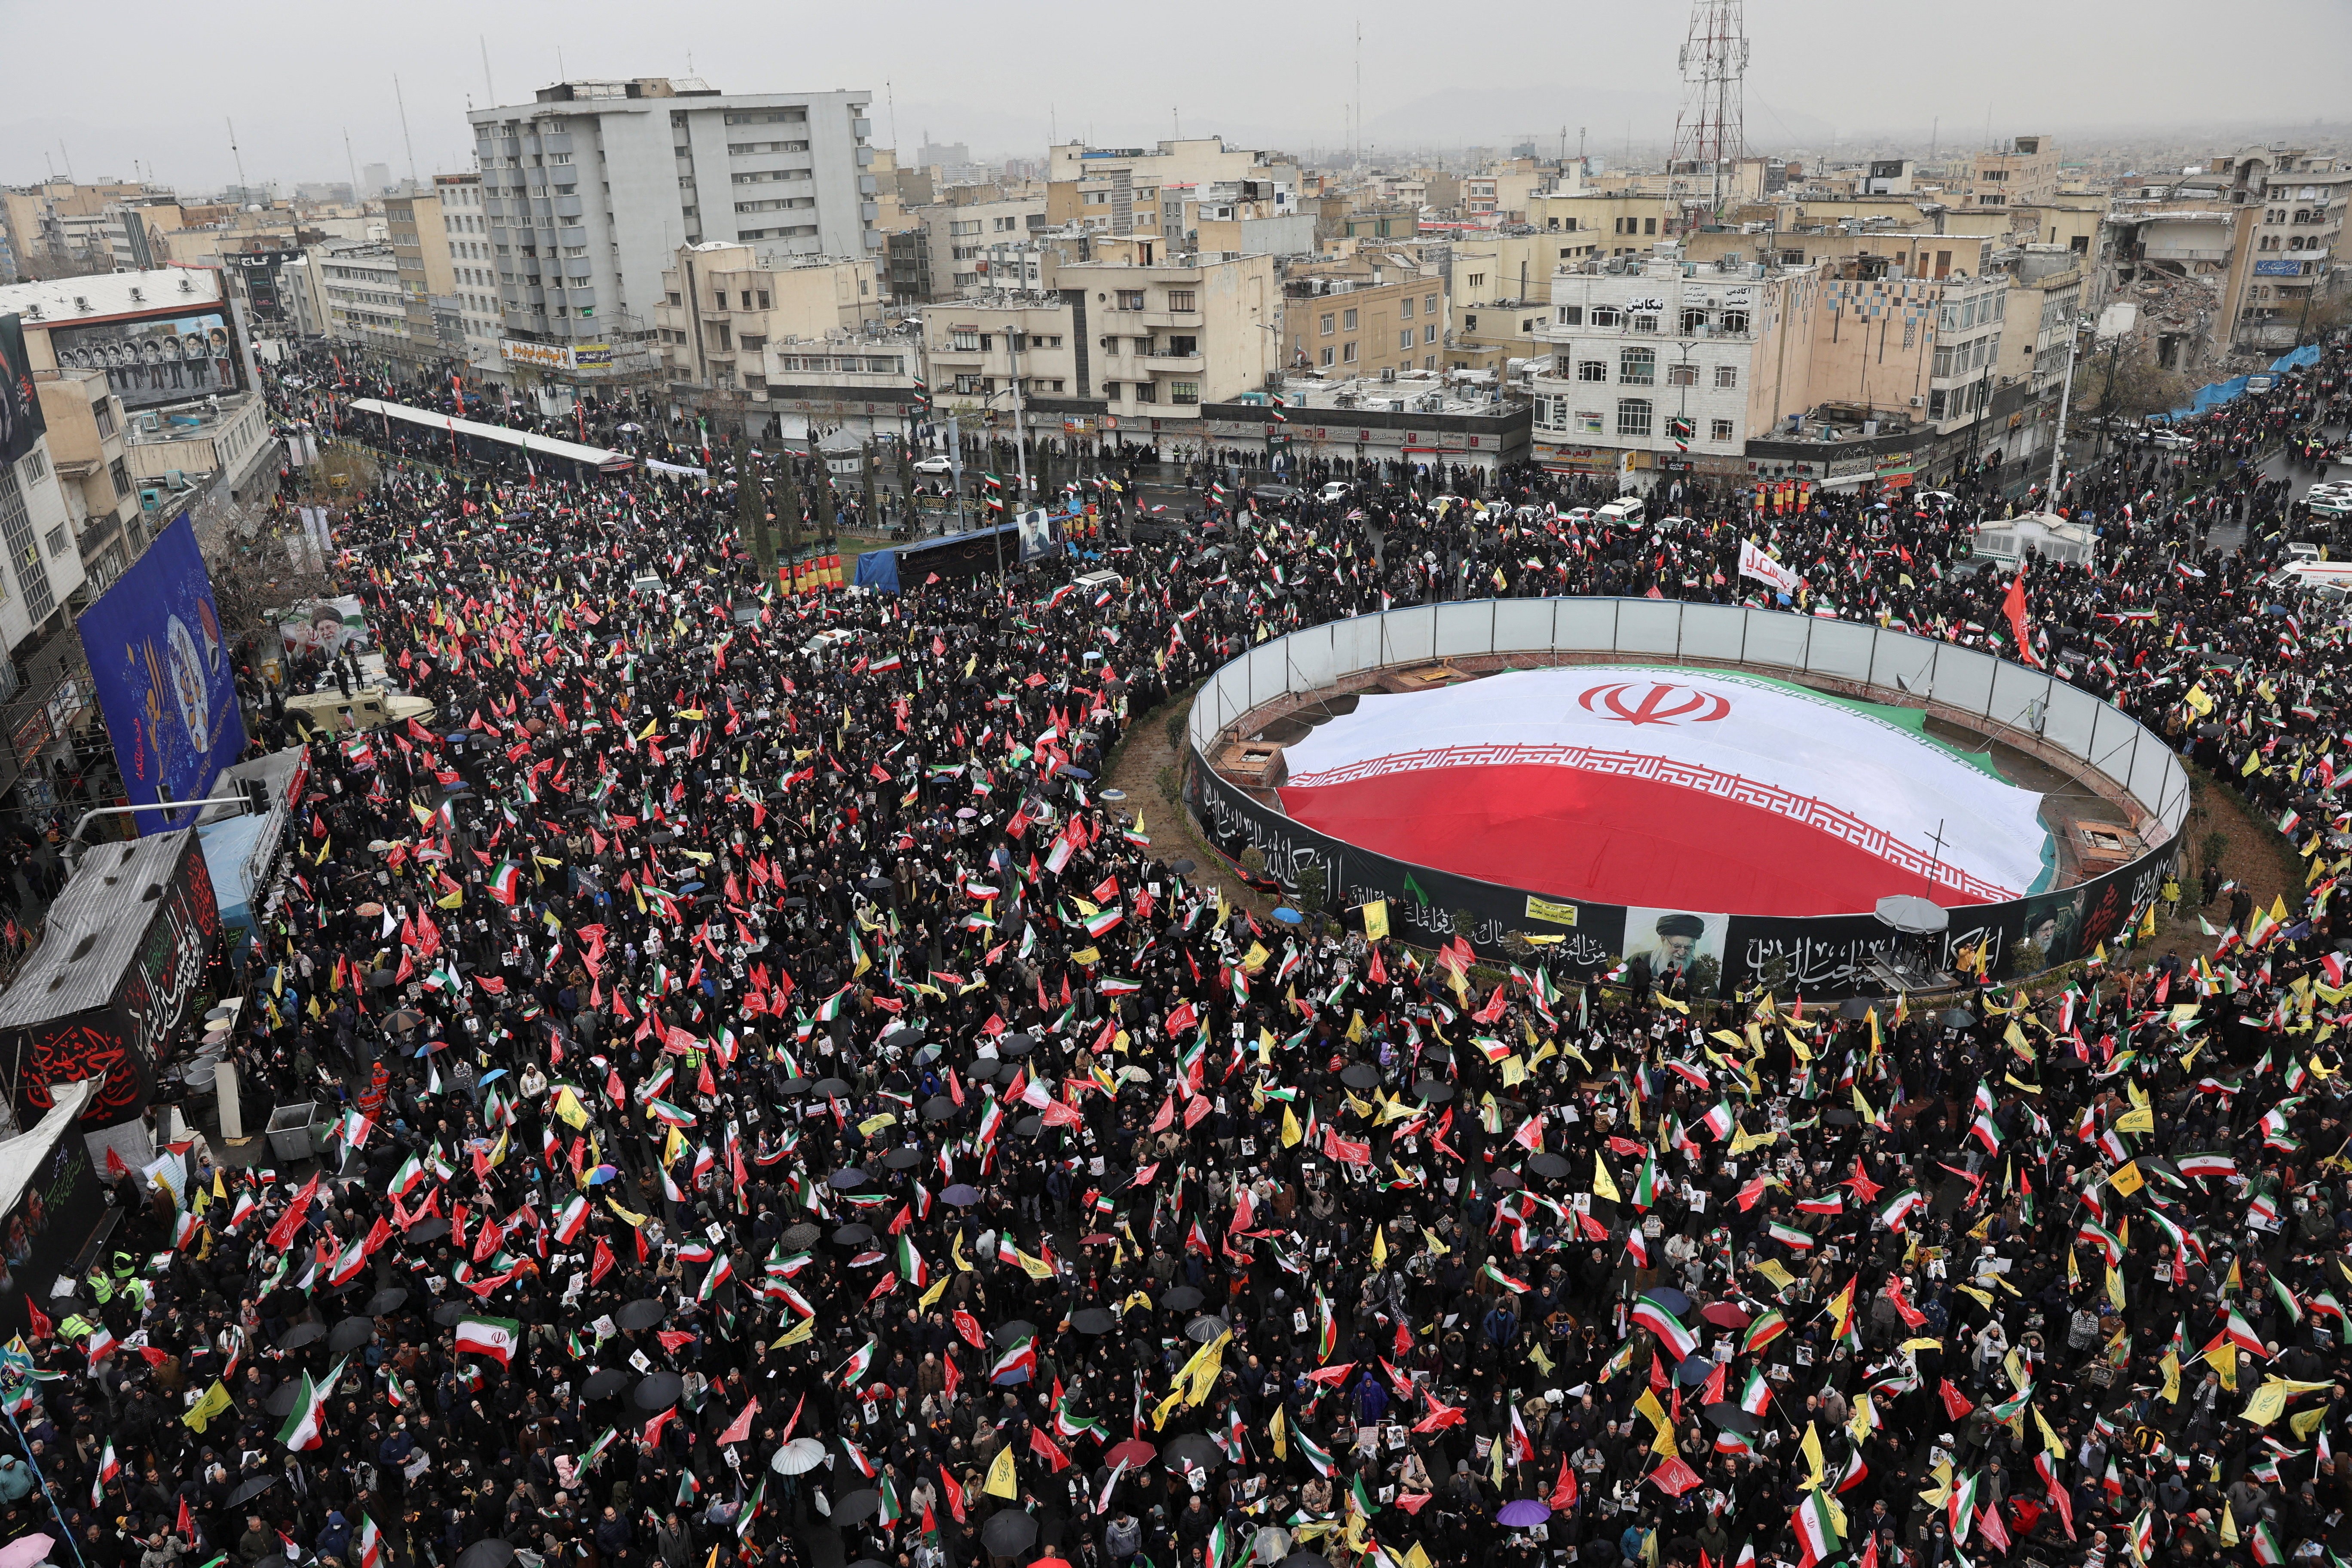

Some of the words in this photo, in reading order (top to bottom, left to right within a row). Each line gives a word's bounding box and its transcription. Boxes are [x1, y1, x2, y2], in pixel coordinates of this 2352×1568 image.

[241, 255, 269, 266] گاج
[2257, 262, 2269, 270] رسمی
[2287, 262, 2298, 271] دفتر
[1727, 287, 1752, 296] آکادمی
[1626, 298, 1663, 313] نیکایش
[1119, 419, 1138, 428] شیلا
[1859, 457, 1870, 469] دکتر
